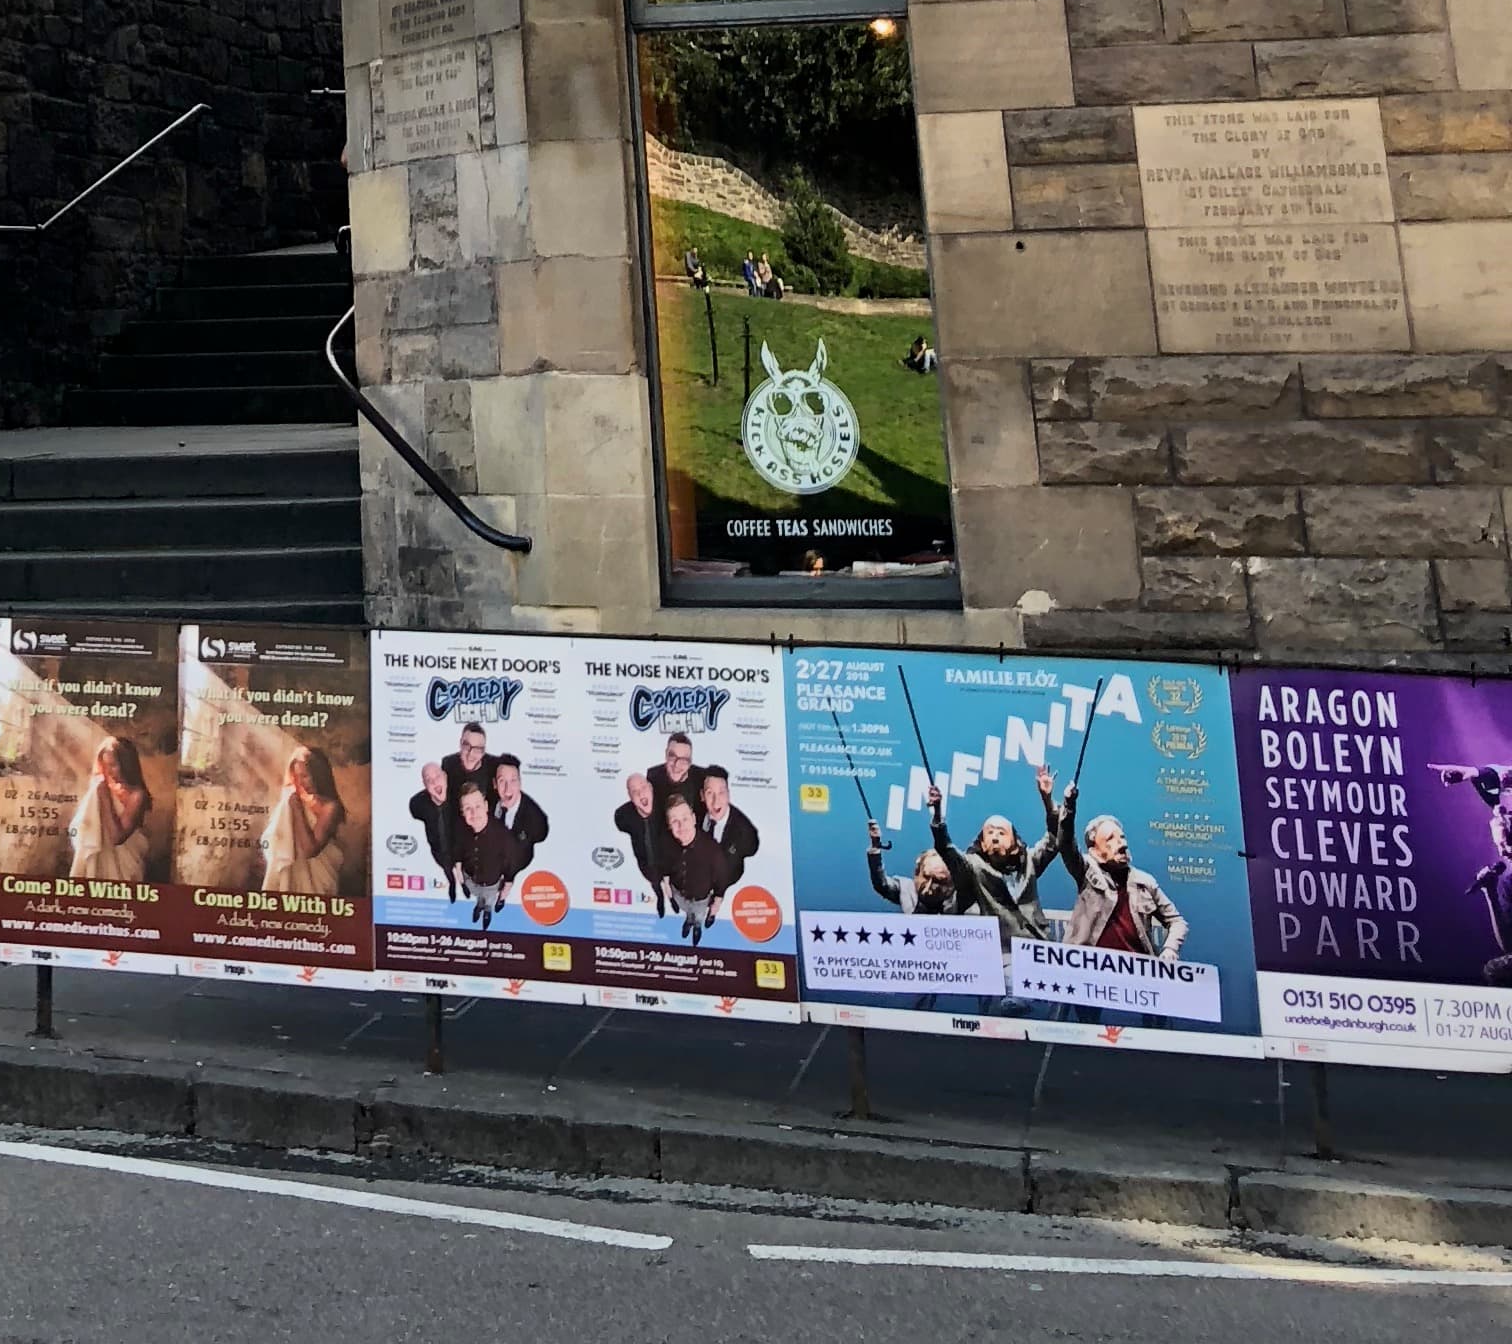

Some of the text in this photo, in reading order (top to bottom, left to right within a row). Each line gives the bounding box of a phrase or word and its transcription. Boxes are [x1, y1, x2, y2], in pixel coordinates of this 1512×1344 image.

[1164, 109, 1350, 127] THIS STONE WAS LAID FOR
[1225, 127, 1325, 142] GLORY GOD
[1252, 147, 1270, 159] BY
[1177, 232, 1335, 247] THIS STONE LAID
[1241, 250, 1284, 261] GLORY
[1268, 266, 1285, 278] BY
[751, 404, 851, 485] KICK ASS HOSTELS
[727, 518, 893, 536] COFFEE TEAS SANDWICHES
[384, 653, 561, 674] THE NOISE NEXT DOOR'S
[585, 661, 770, 683] THE NOISE NEXT DOOR'S
[846, 661, 885, 672] AUGUST
[945, 668, 1059, 688] FAMILIE FLÖZ
[8, 678, 162, 698] What if you didn't know
[197, 686, 354, 707] What if you didn't know
[796, 683, 886, 701] PLEASANCE
[427, 677, 523, 721] COMEDY
[630, 685, 731, 731] COMEDY
[797, 697, 854, 713] GRAND
[1258, 685, 1398, 729] ARAGON
[28, 701, 137, 718] you were dead?
[218, 711, 329, 728] you were dead?
[852, 723, 889, 735] 1.30PM
[799, 742, 892, 756] PLEASANCE.CO.UK
[886, 673, 1143, 831] INFINITA
[1261, 729, 1405, 776] BOLEYN
[808, 787, 823, 798] 33
[1265, 776, 1408, 817] SEYMOUR
[19, 805, 59, 820] 15:55
[218, 801, 269, 815] 26 August
[209, 817, 250, 832] 15:55
[1270, 817, 1414, 868] CLEVES
[1168, 865, 1216, 876] MASTERFUL!
[3, 876, 160, 902] Come Die With Us
[1274, 868, 1417, 912] HOWARD
[24, 898, 136, 923] A dark, new comedy.
[194, 888, 355, 916] Come Die With Us
[1, 918, 161, 940] www.comediewithus.com
[217, 911, 332, 938] A dark, new comedy.
[924, 927, 993, 940] EDINBURGH
[192, 932, 356, 955] www.comediewithus.com
[387, 932, 488, 950] 10:50pm August
[925, 939, 961, 951] GUIDE
[1278, 912, 1423, 963] PARR
[551, 945, 564, 956] 33
[595, 946, 698, 966] 10:50pm 1-26 August
[763, 963, 778, 974] 33
[813, 957, 948, 970] "A PHYSICAL SYMPHONY
[1021, 943, 1205, 983] "ENCHANTING"
[813, 967, 978, 983] TO LIFE, LOVE AND MEMORY!"
[1083, 983, 1160, 1008] THE LIST
[1283, 988, 1416, 1015] 0131 510 0395
[1434, 999, 1501, 1020] 7.30PM
[952, 1017, 981, 1032] fringe
[1284, 1015, 1416, 1033] underbellyedinburgh.co.uk
[1435, 1023, 1474, 1038] 01-27
